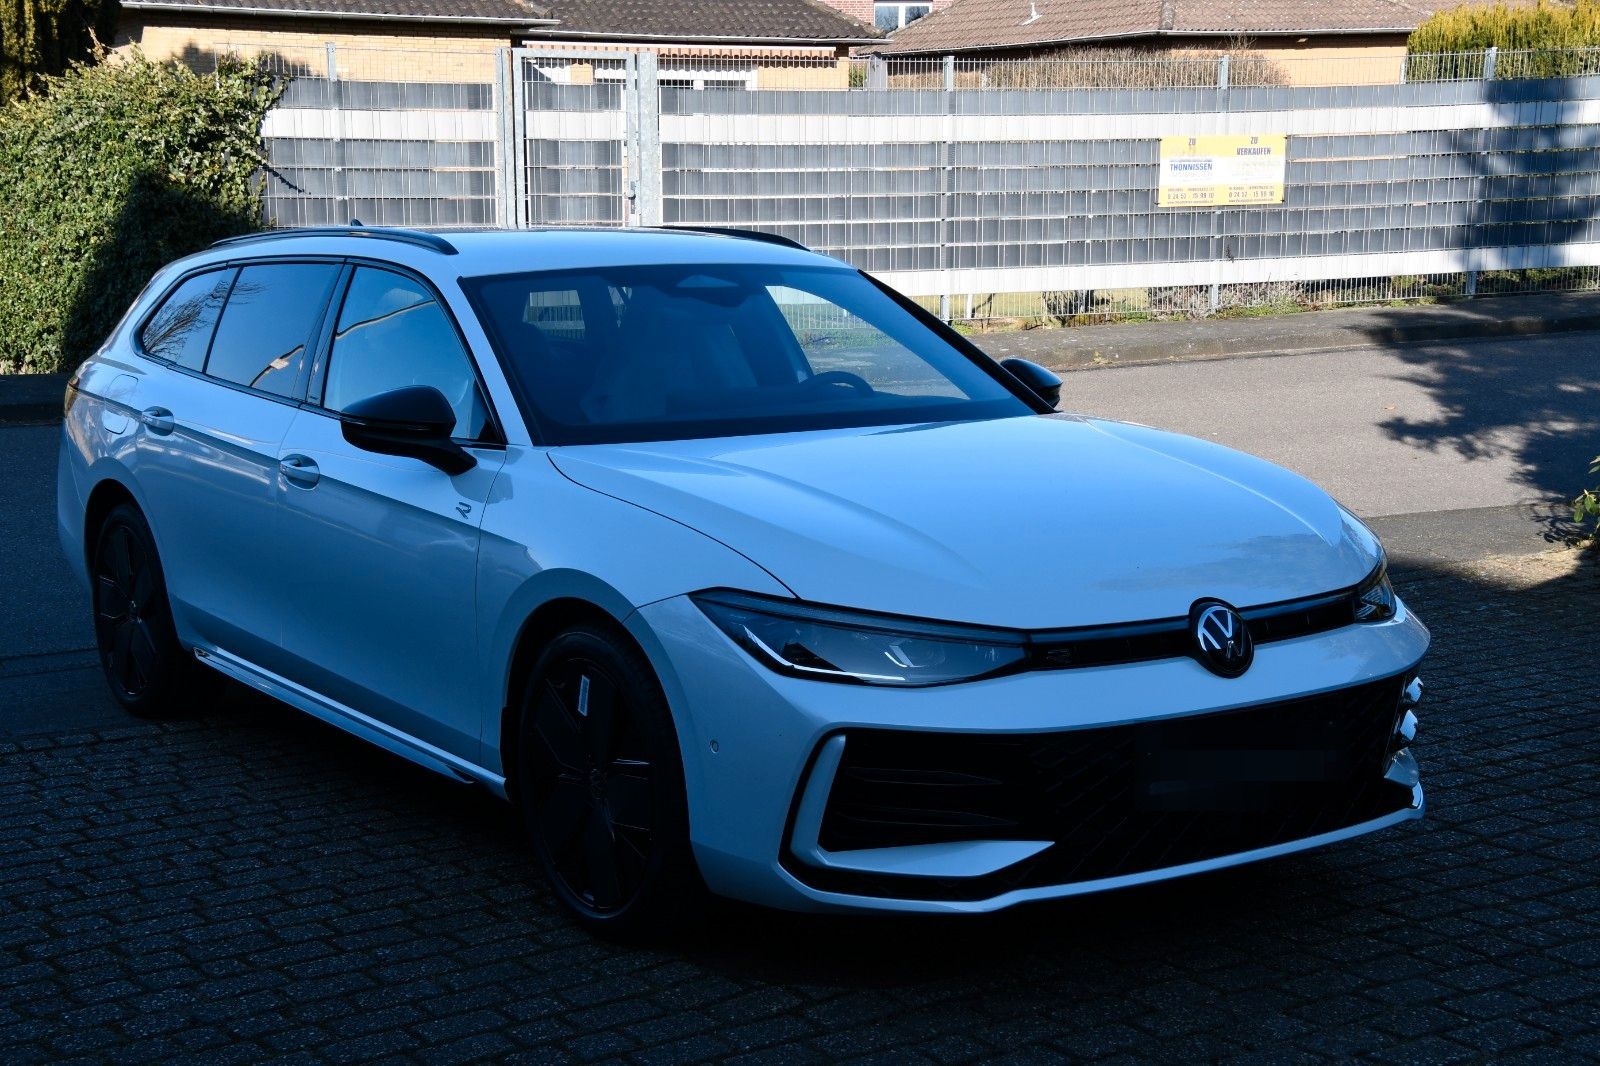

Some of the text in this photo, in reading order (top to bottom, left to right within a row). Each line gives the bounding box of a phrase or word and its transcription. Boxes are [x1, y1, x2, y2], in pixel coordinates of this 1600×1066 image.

[1188, 138, 1197, 146] ZU
[1250, 136, 1258, 144] ZU
[1236, 147, 1271, 155] VERKAUFEN
